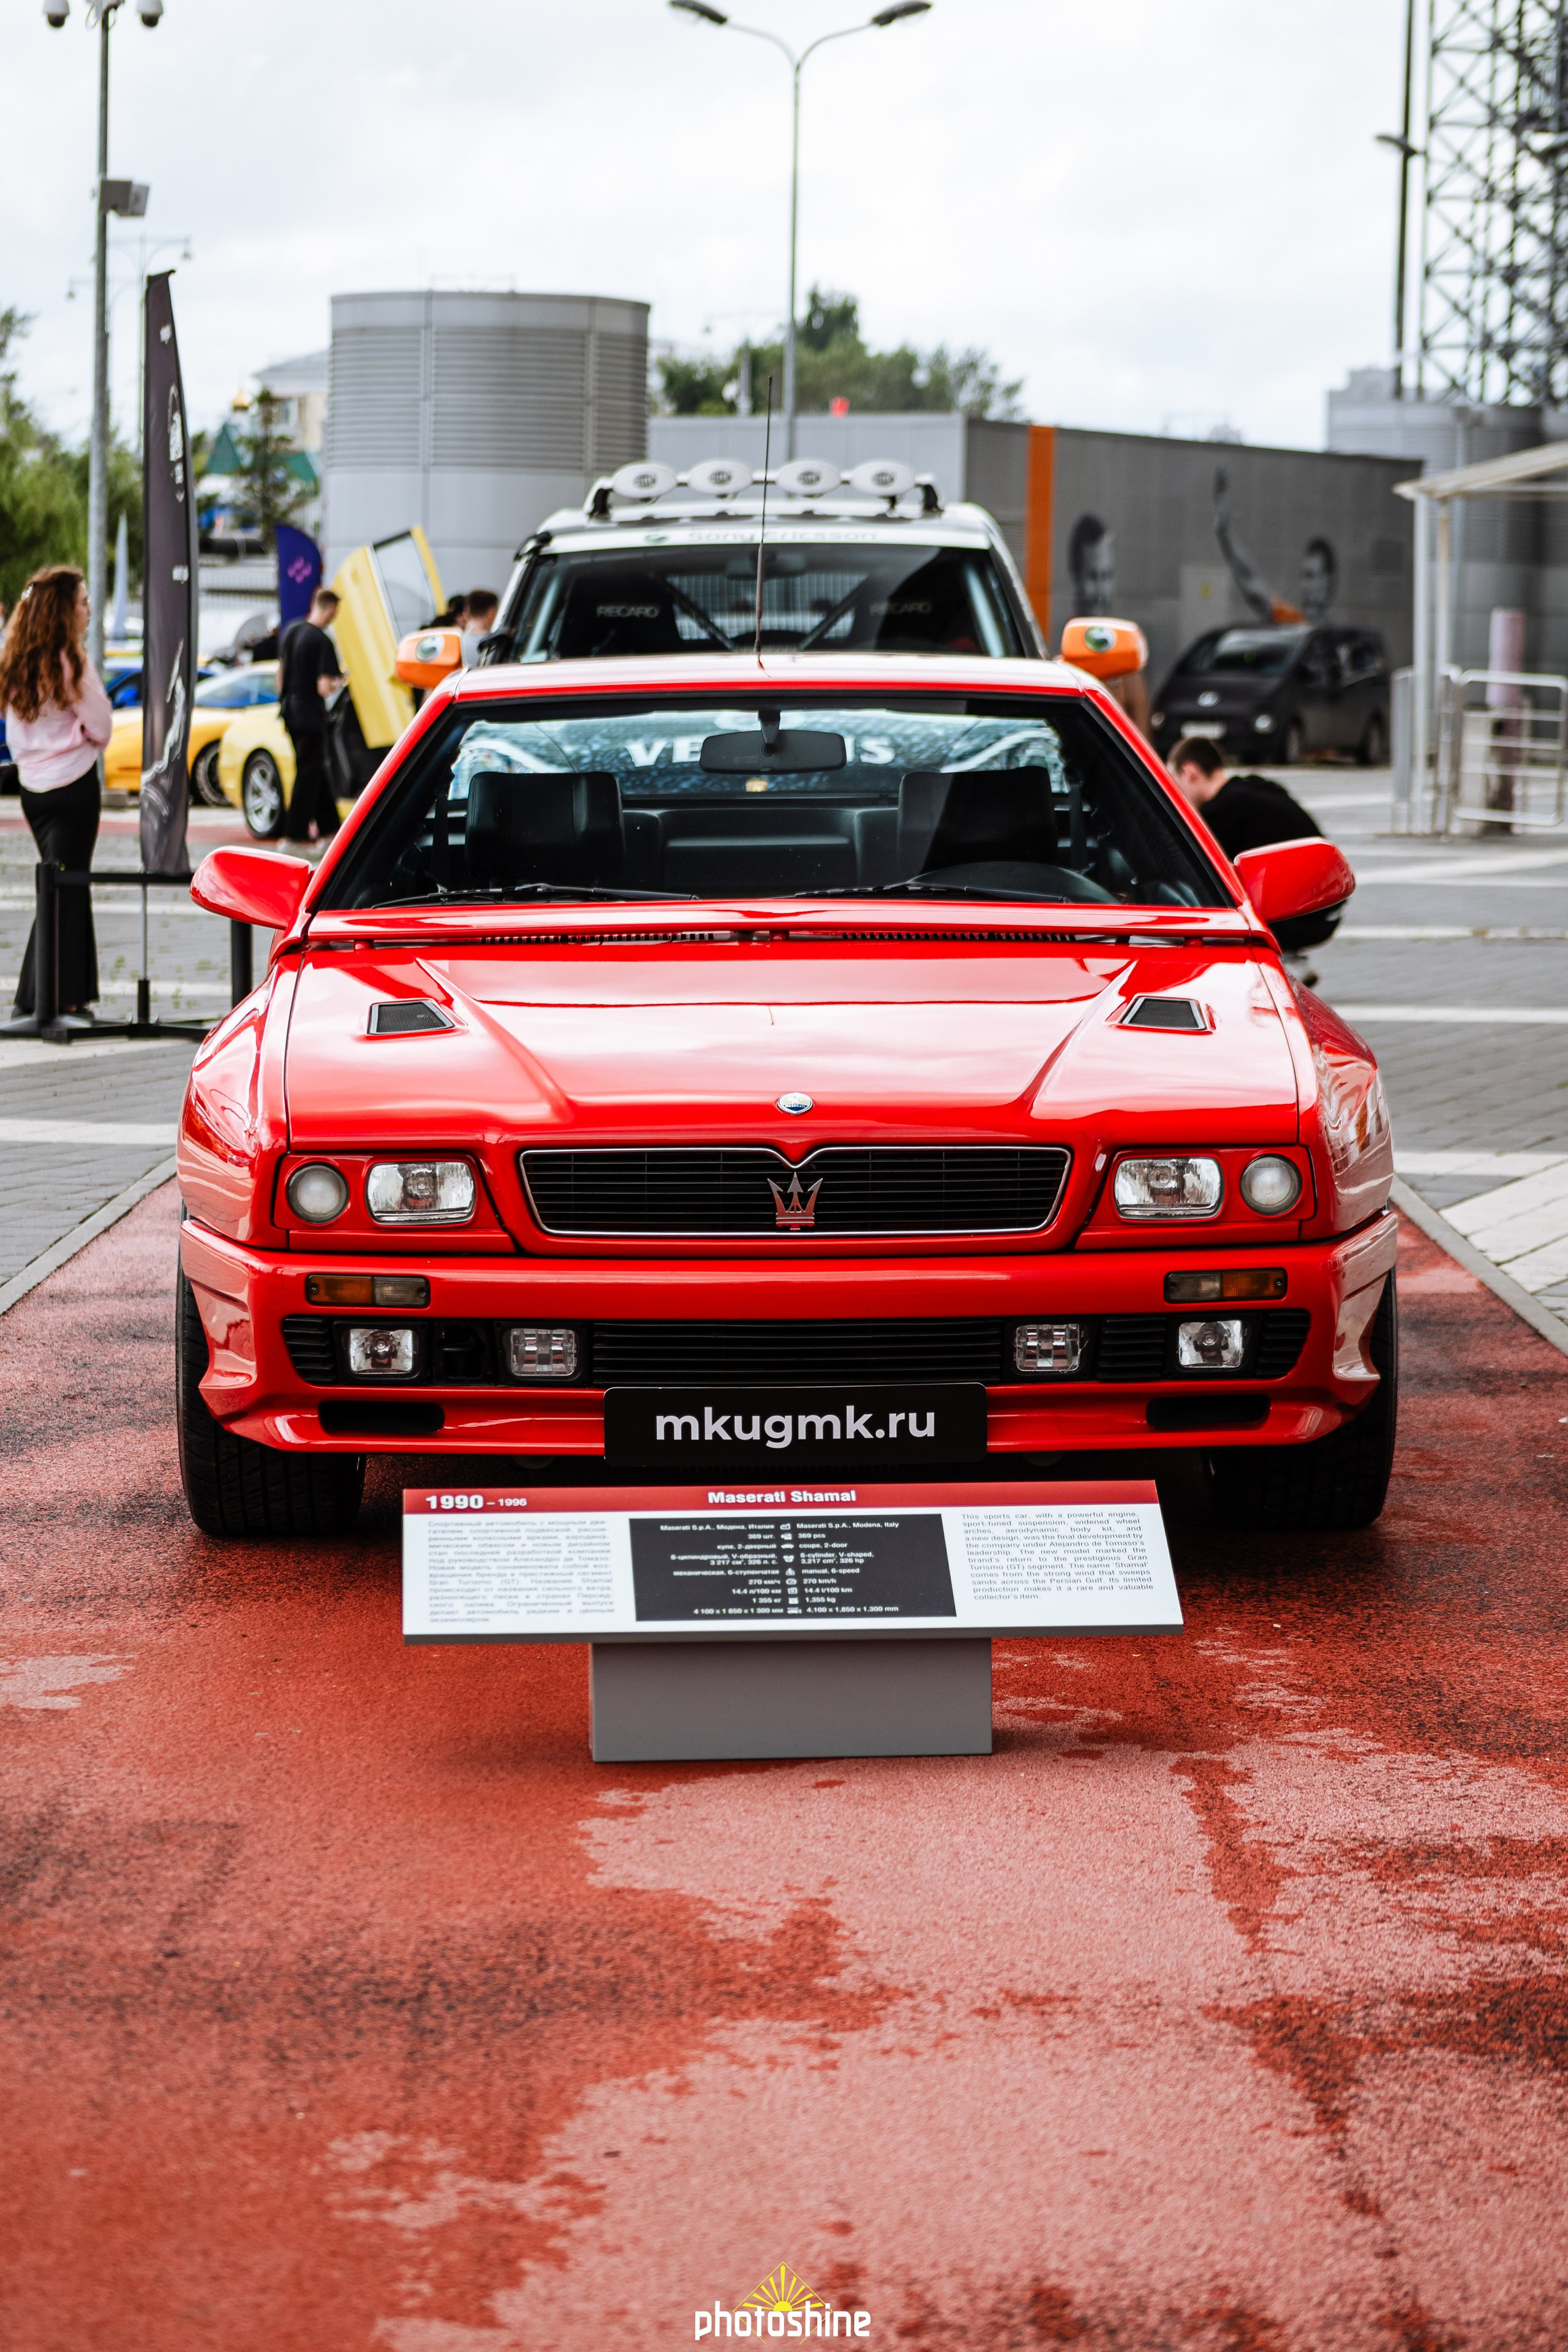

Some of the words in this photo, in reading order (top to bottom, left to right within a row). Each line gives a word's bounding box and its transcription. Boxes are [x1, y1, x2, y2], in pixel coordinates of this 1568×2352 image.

[656, 1405, 935, 1449] mkugmk.ru
[426, 1494, 484, 1509] 1990
[498, 1498, 527, 1507] 1996
[707, 1491, 785, 1504] Maserati
[790, 1490, 856, 1502] Shamal
